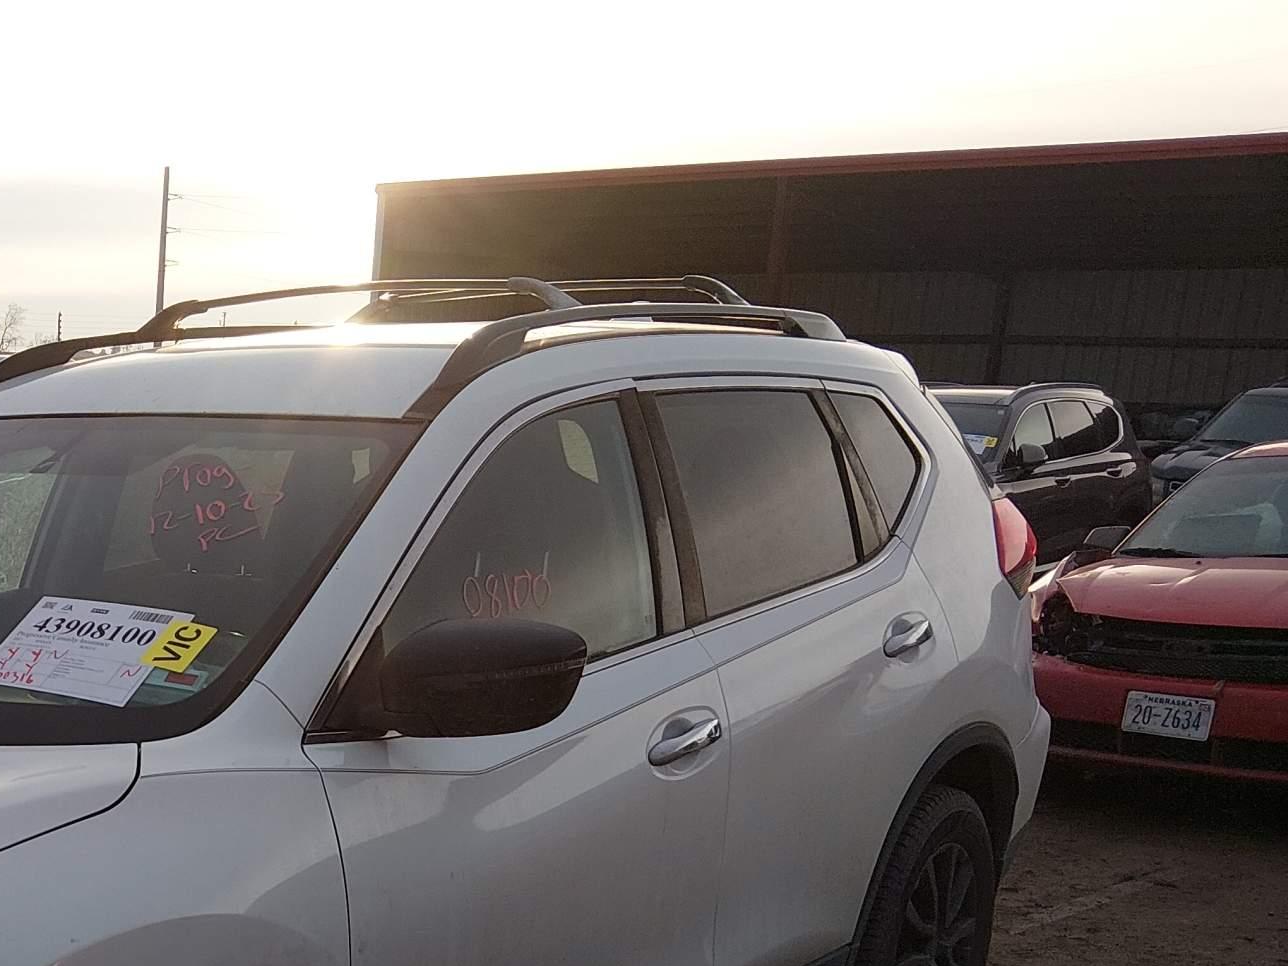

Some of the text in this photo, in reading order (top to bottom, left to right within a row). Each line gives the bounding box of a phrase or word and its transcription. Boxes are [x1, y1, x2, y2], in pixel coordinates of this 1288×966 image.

[463, 569, 552, 618] 08100
[32, 616, 158, 647] 43908100
[152, 625, 202, 663] VIC
[1131, 703, 1203, 731] 20-Z634
[1147, 696, 1193, 707] NEBRASKA
